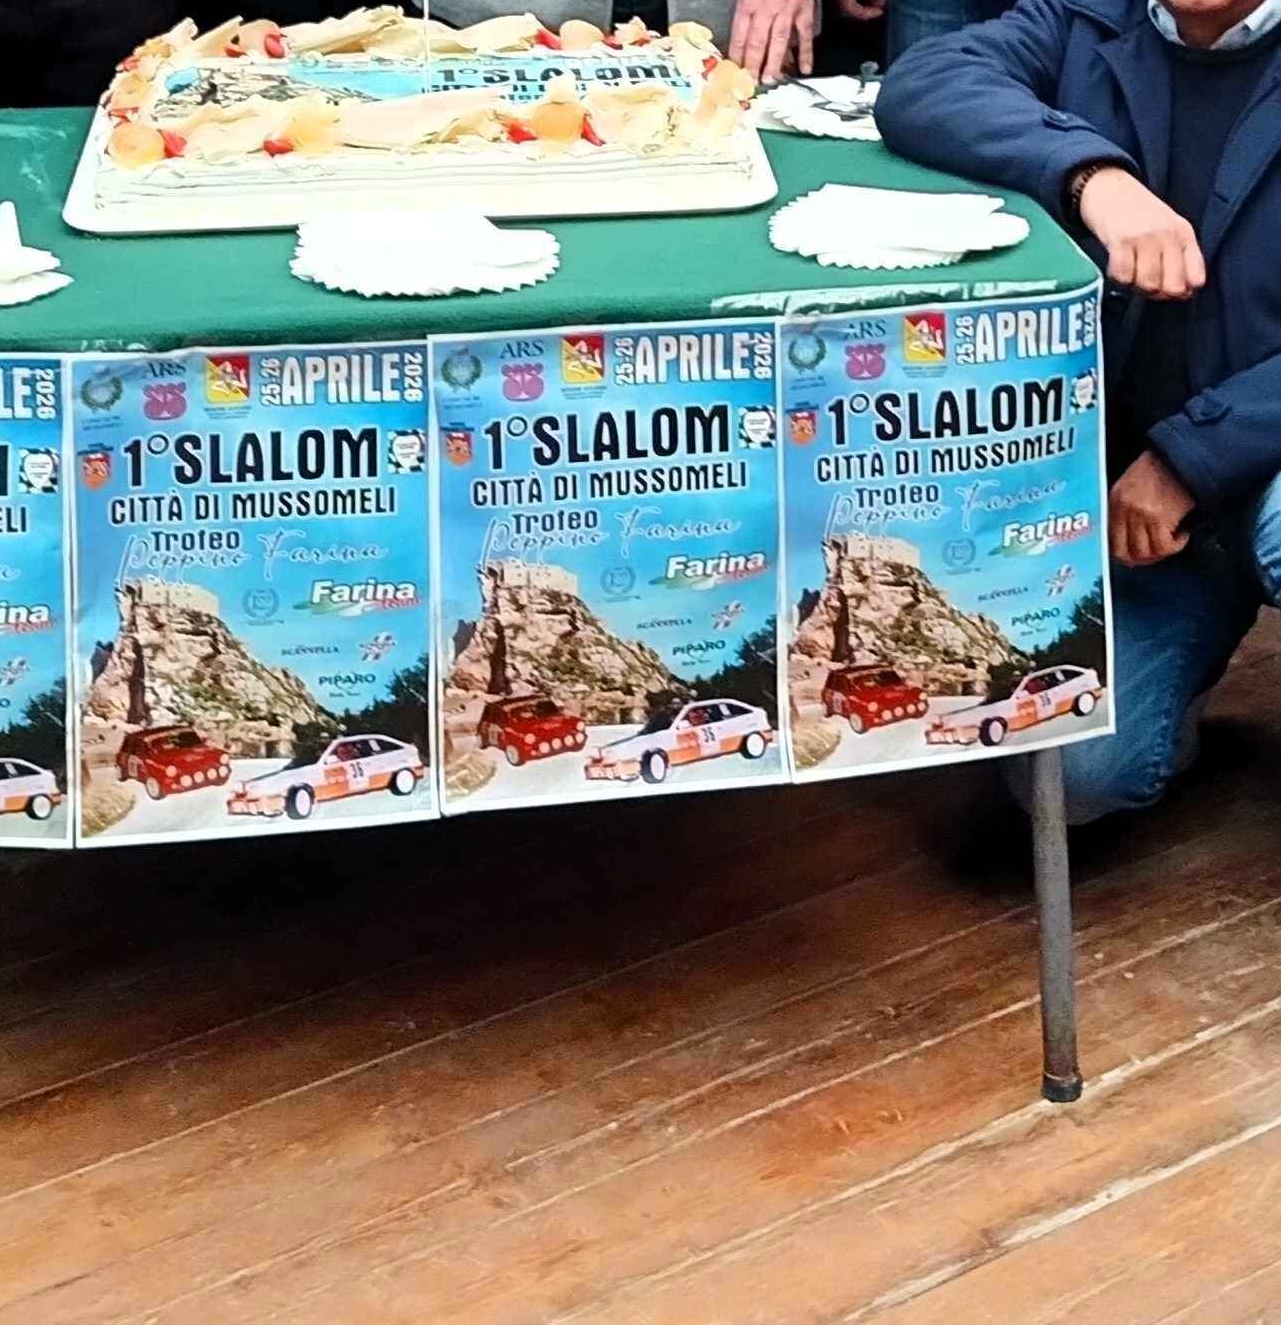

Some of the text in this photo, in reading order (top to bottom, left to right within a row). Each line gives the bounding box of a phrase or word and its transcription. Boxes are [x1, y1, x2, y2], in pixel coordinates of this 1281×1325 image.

[499, 338, 545, 360] ARS
[975, 302, 1085, 365] APRILE
[635, 331, 751, 385] APRILE
[281, 352, 402, 406] APRILE
[816, 426, 1076, 483] CITTÀ DI MUSSOMELI
[472, 461, 748, 507] CITTÀ DI MUSSOMELI
[854, 483, 940, 509] Trofeo
[110, 486, 396, 525] CITTÀ DI MUSSOMELI
[510, 510, 599, 534] Trofeo
[149, 530, 240, 552] Trofeo
[1002, 509, 1092, 548] Farina
[666, 550, 768, 580] Farina
[311, 577, 417, 605] Farina
[318, 673, 377, 688] PIPARO
